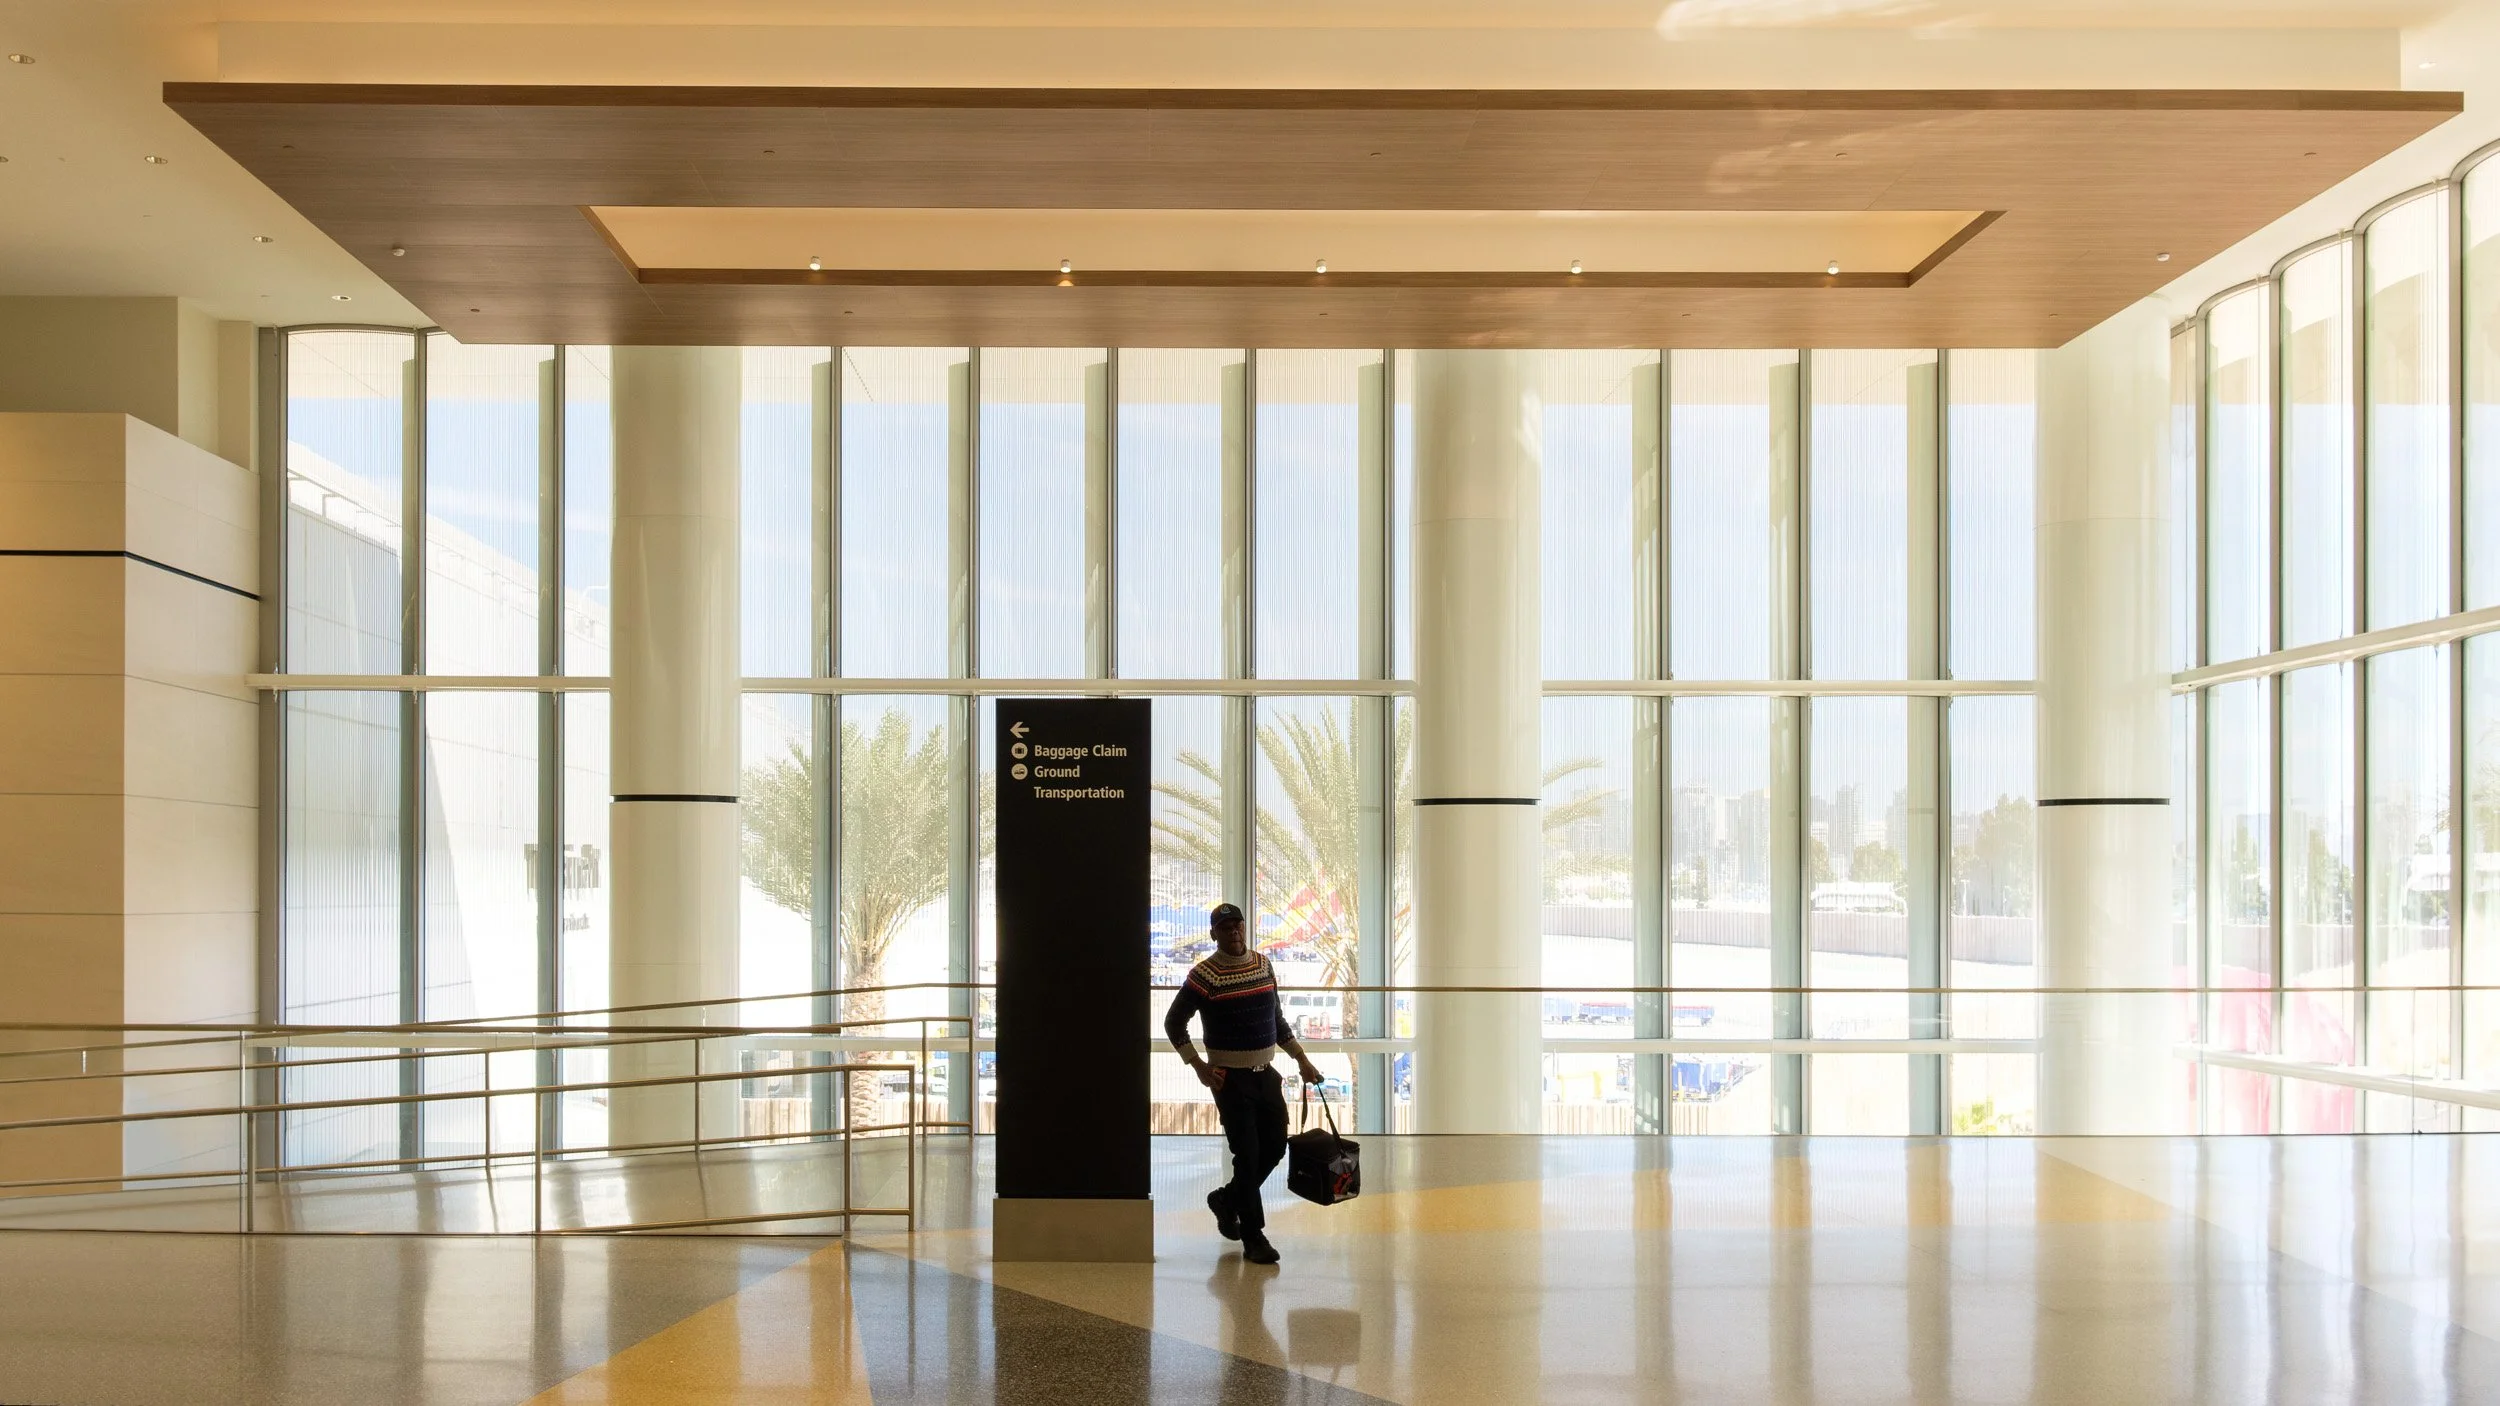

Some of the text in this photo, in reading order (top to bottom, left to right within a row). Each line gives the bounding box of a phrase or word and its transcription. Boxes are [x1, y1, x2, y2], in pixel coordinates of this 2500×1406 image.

[1034, 744, 1127, 760] Baggage Claim
[1034, 765, 1080, 778] Ground
[1034, 786, 1125, 801] Transportation
